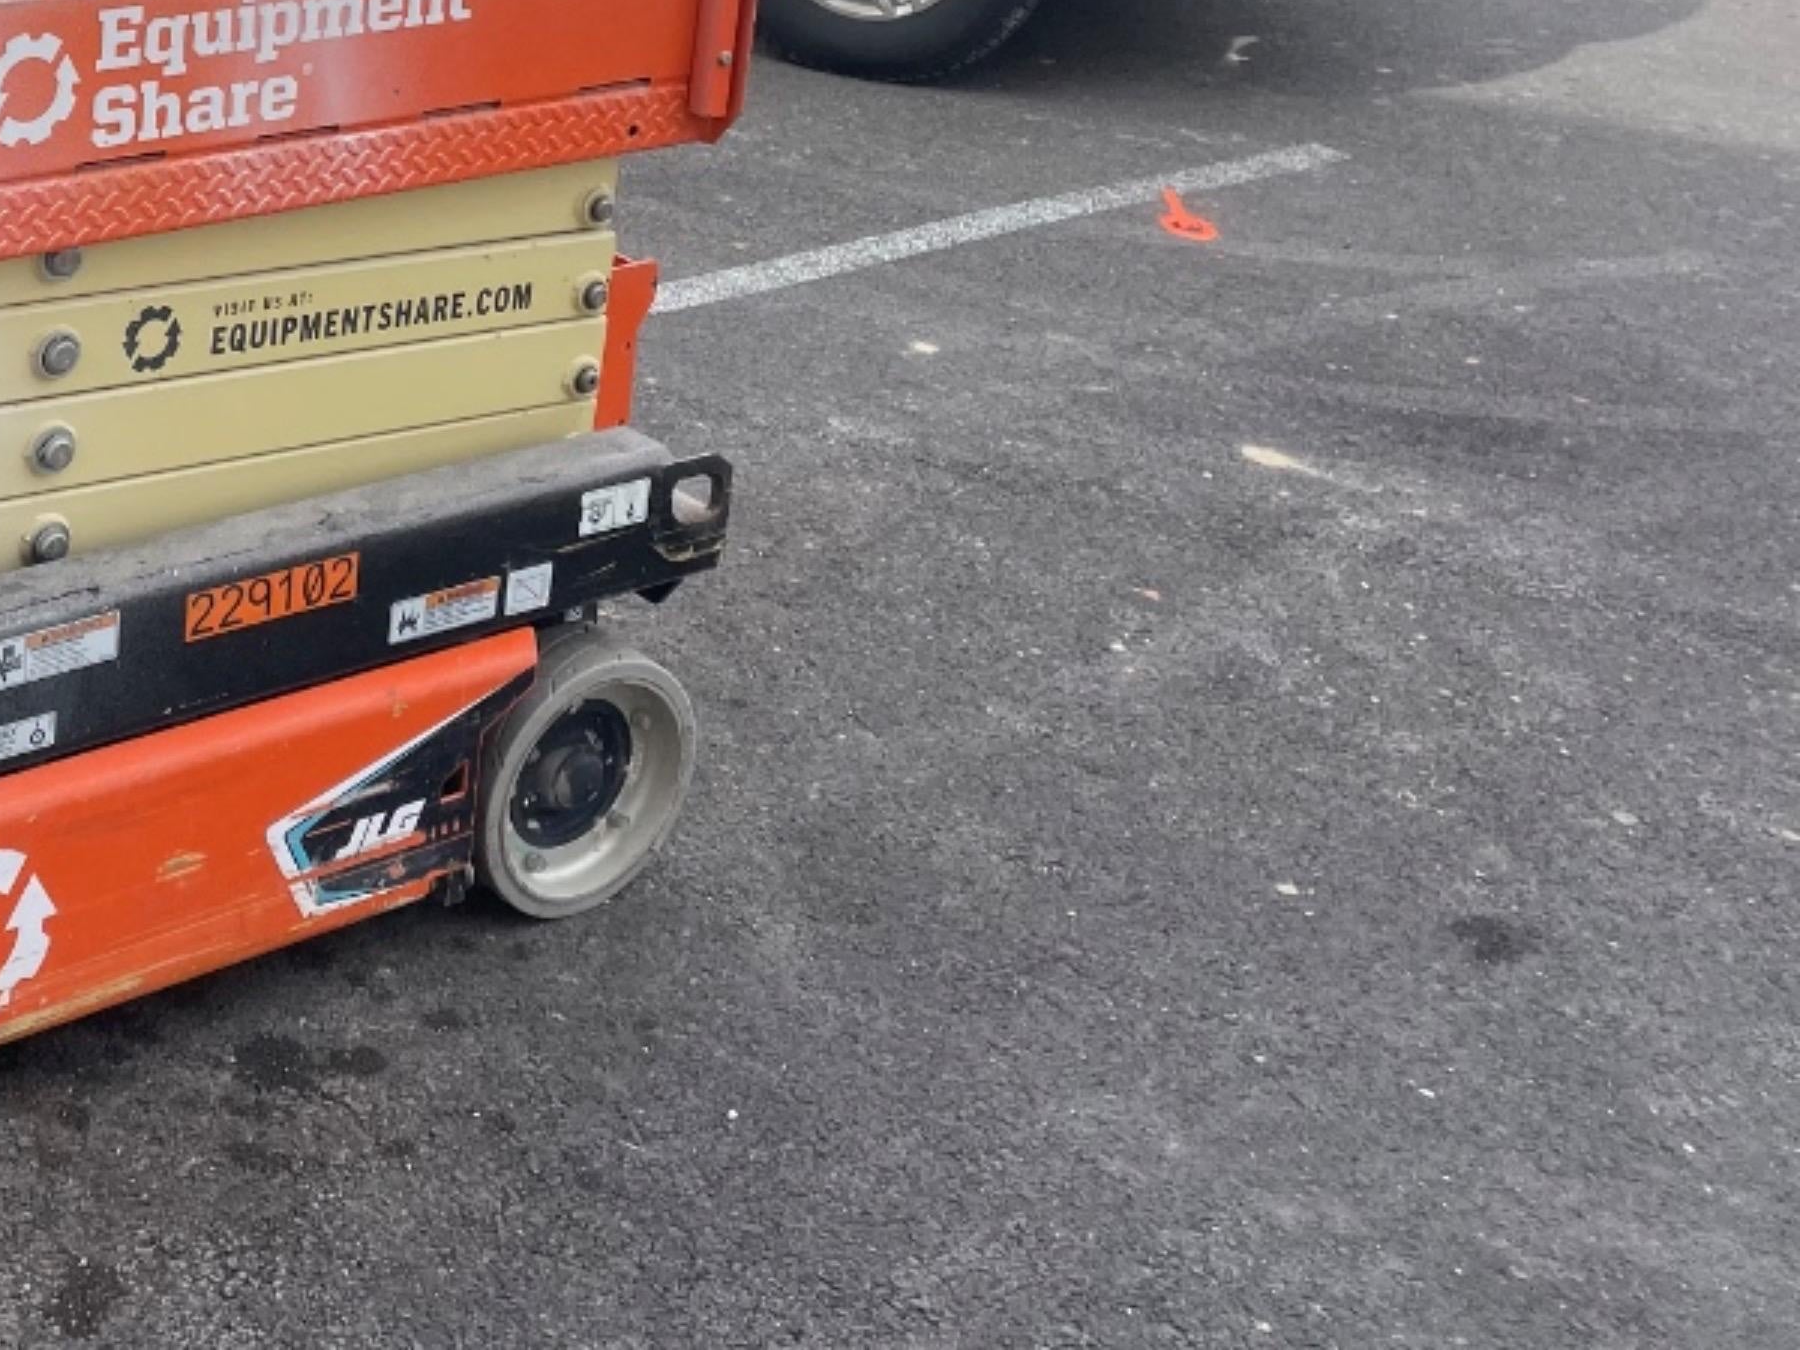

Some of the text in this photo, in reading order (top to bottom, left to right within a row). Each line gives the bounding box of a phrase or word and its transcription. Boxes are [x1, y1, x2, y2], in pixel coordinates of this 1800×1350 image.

[91, 74, 299, 149] Share
[209, 281, 534, 355] EQUIPMENTSHARE.COM
[190, 557, 355, 637] 229102
[334, 798, 427, 860] JLG
